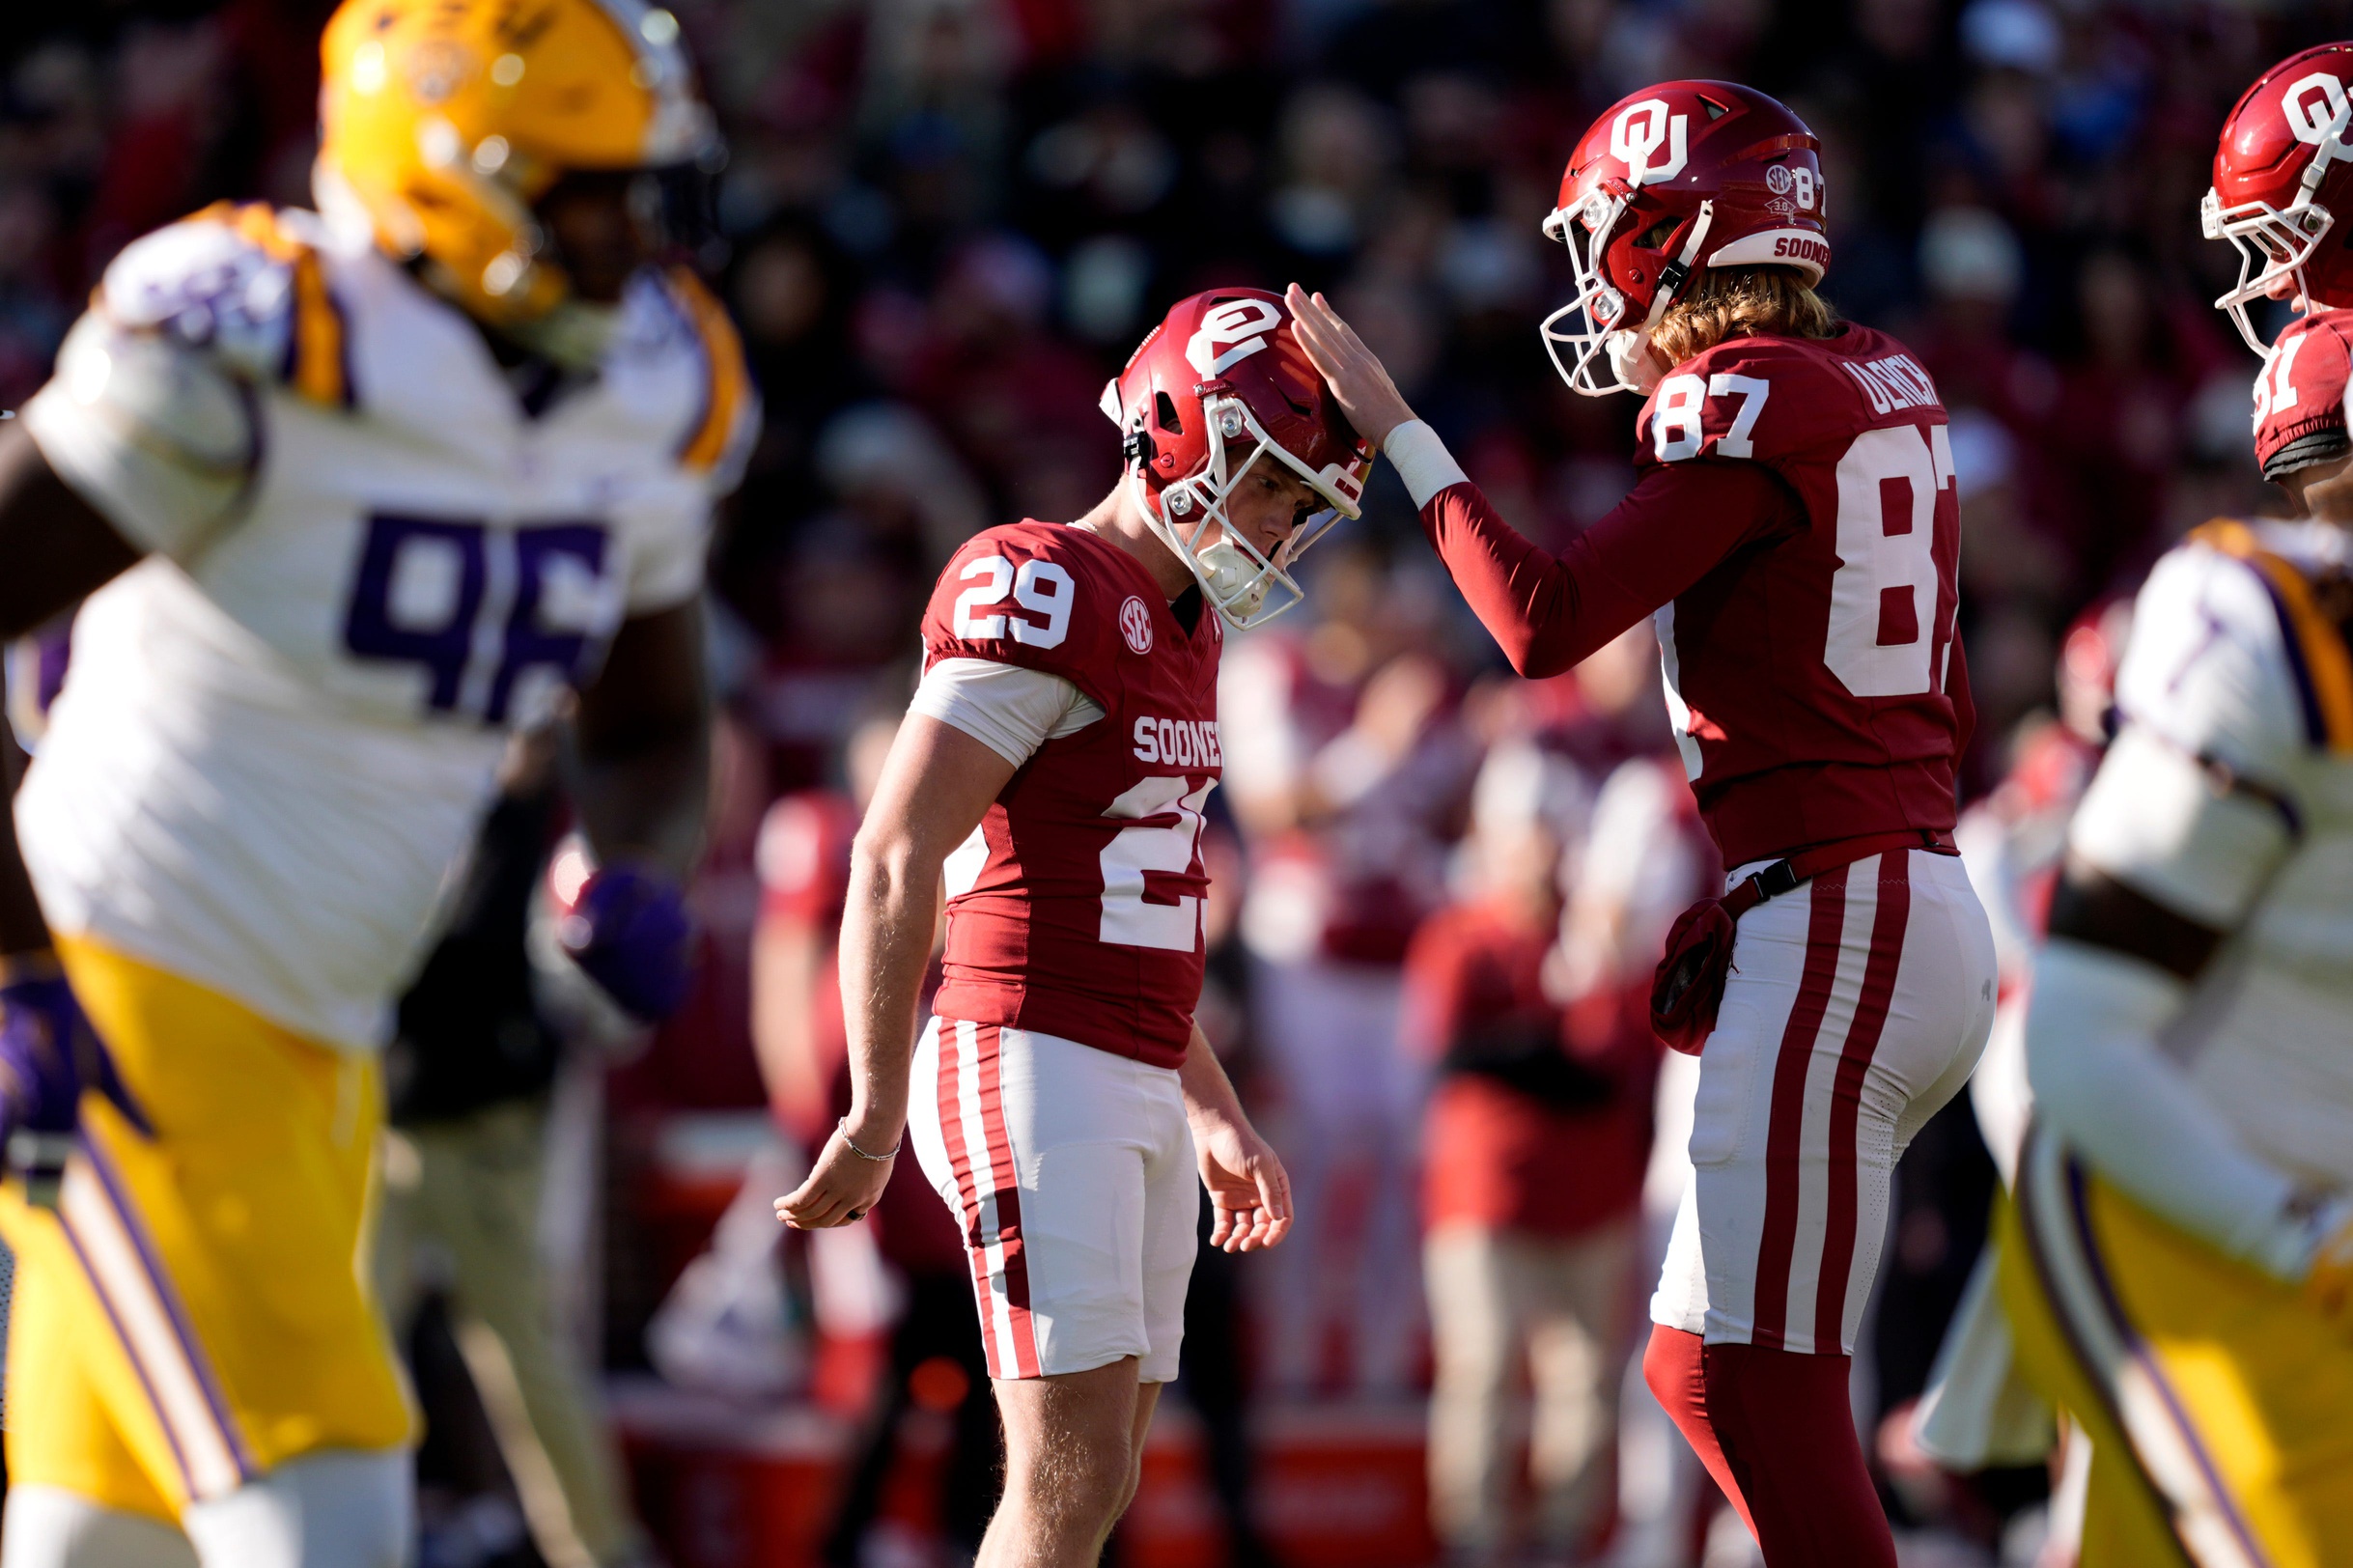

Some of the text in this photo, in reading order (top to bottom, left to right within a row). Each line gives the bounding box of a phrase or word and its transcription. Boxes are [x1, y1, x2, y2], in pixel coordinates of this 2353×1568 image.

[1610, 98, 1688, 185] OU
[2282, 71, 2353, 162] O
[1769, 167, 1790, 192] SEC
[1774, 201, 1789, 211] 3.0
[1186, 298, 1282, 375] OU
[1651, 374, 1770, 462] 87
[1841, 353, 1941, 415] ULRICH
[952, 555, 1076, 651] 29
[1122, 599, 1152, 652] SEC
